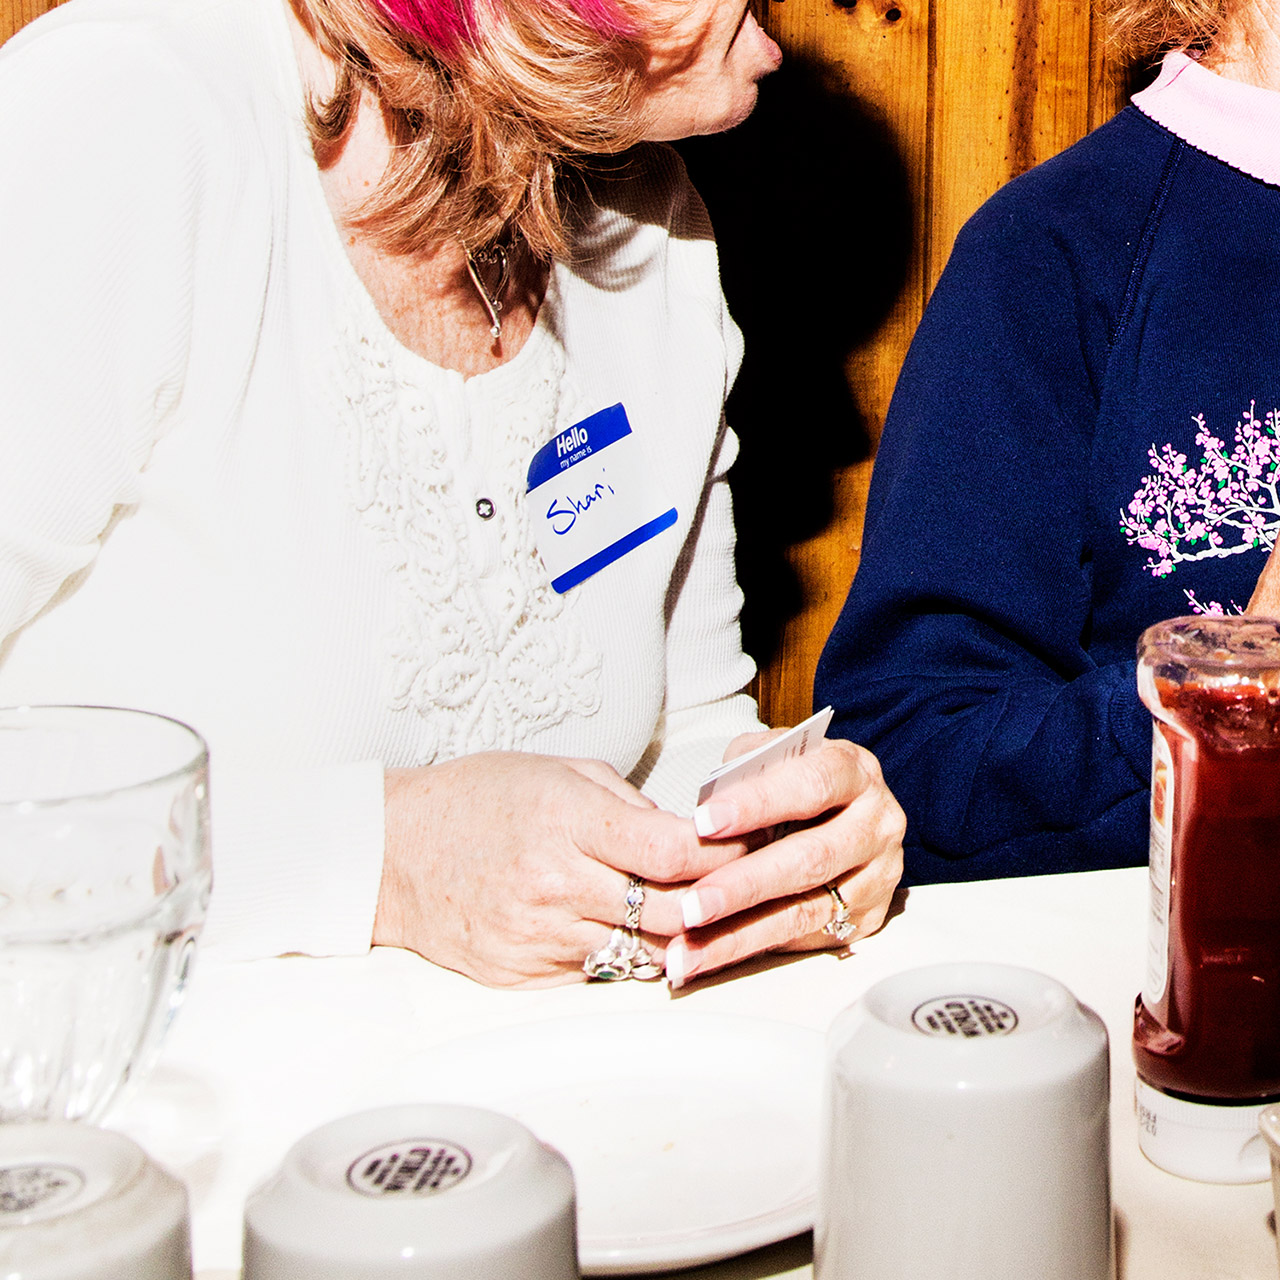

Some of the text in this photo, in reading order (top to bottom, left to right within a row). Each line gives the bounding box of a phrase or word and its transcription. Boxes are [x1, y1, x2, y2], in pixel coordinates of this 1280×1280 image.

[555, 426, 589, 458] Hello
[559, 444, 593, 470] my name is
[546, 467, 615, 536] Shari
